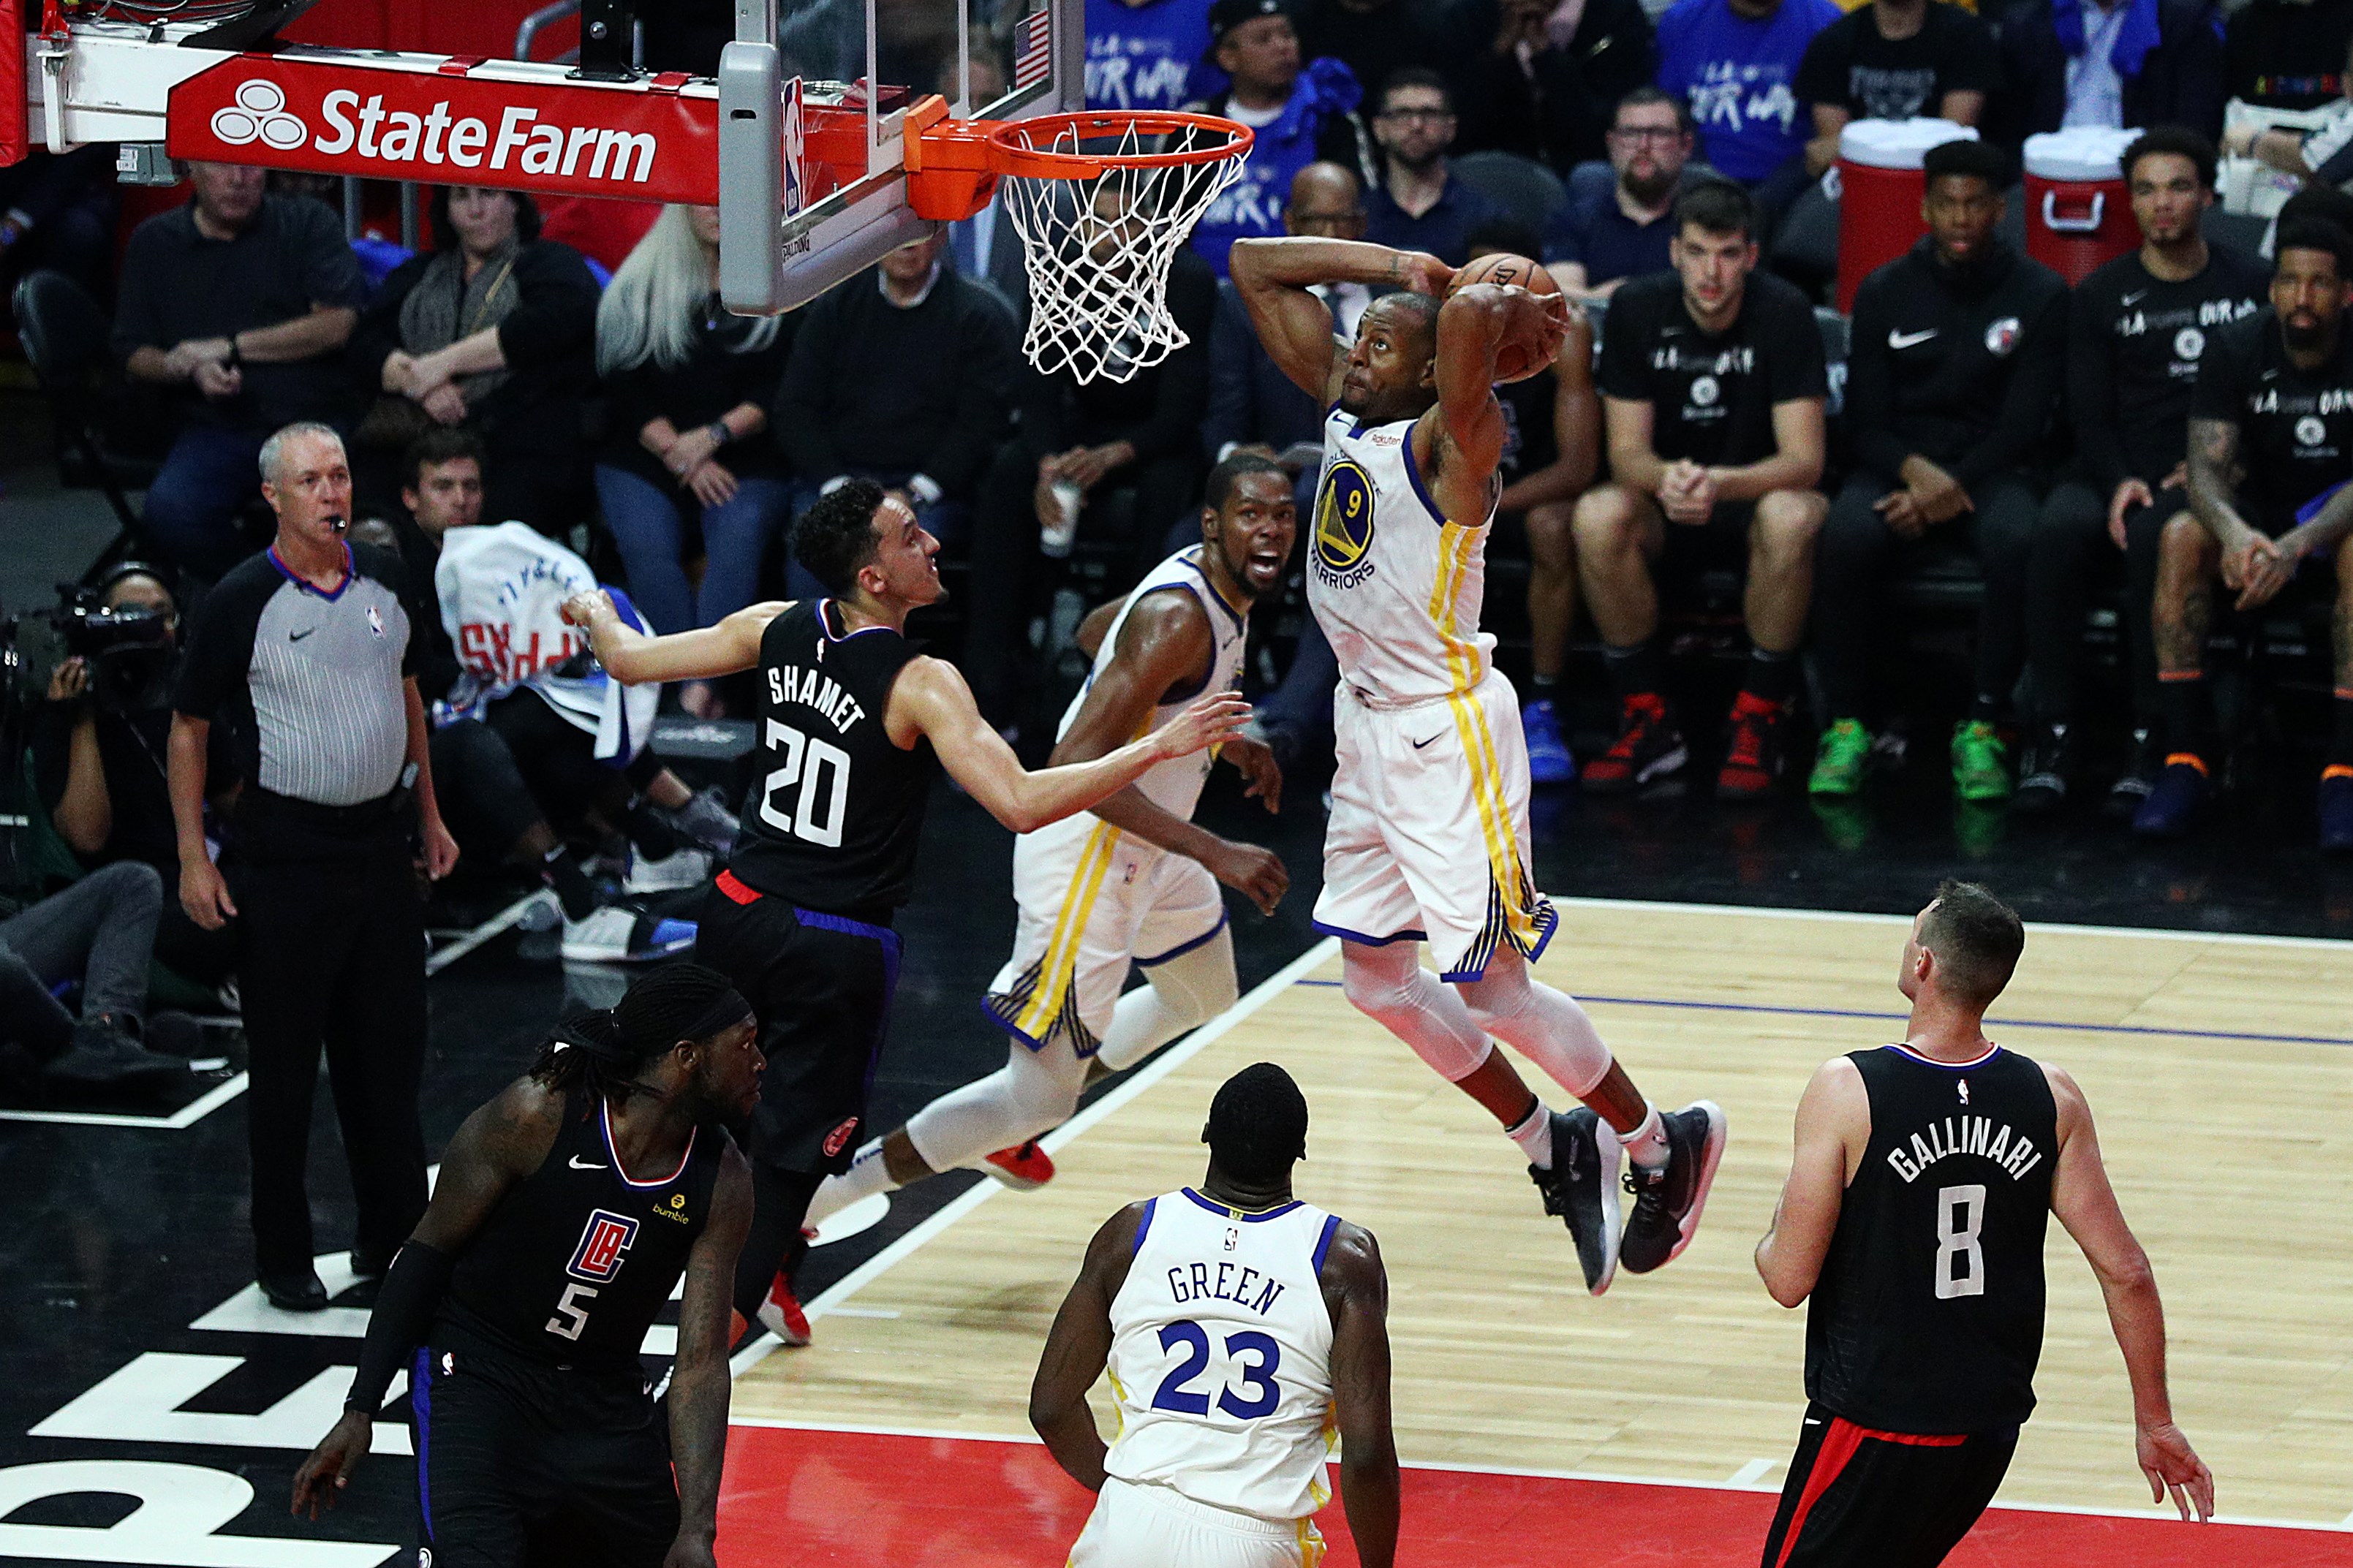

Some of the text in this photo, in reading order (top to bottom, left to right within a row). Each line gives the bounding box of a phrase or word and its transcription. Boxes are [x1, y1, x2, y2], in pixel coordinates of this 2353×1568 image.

[782, 230, 809, 263] PALDING
[1346, 489, 1362, 518] 9
[768, 664, 866, 734] SHAMET
[760, 716, 851, 848] 20
[1886, 1115, 2042, 1183] GALLINARI
[652, 1203, 690, 1225] bumble
[1935, 1184, 1987, 1299] 8
[545, 1282, 599, 1341] 5
[1168, 1262, 1285, 1316] GREEN
[1150, 1319, 1281, 1420] 23
